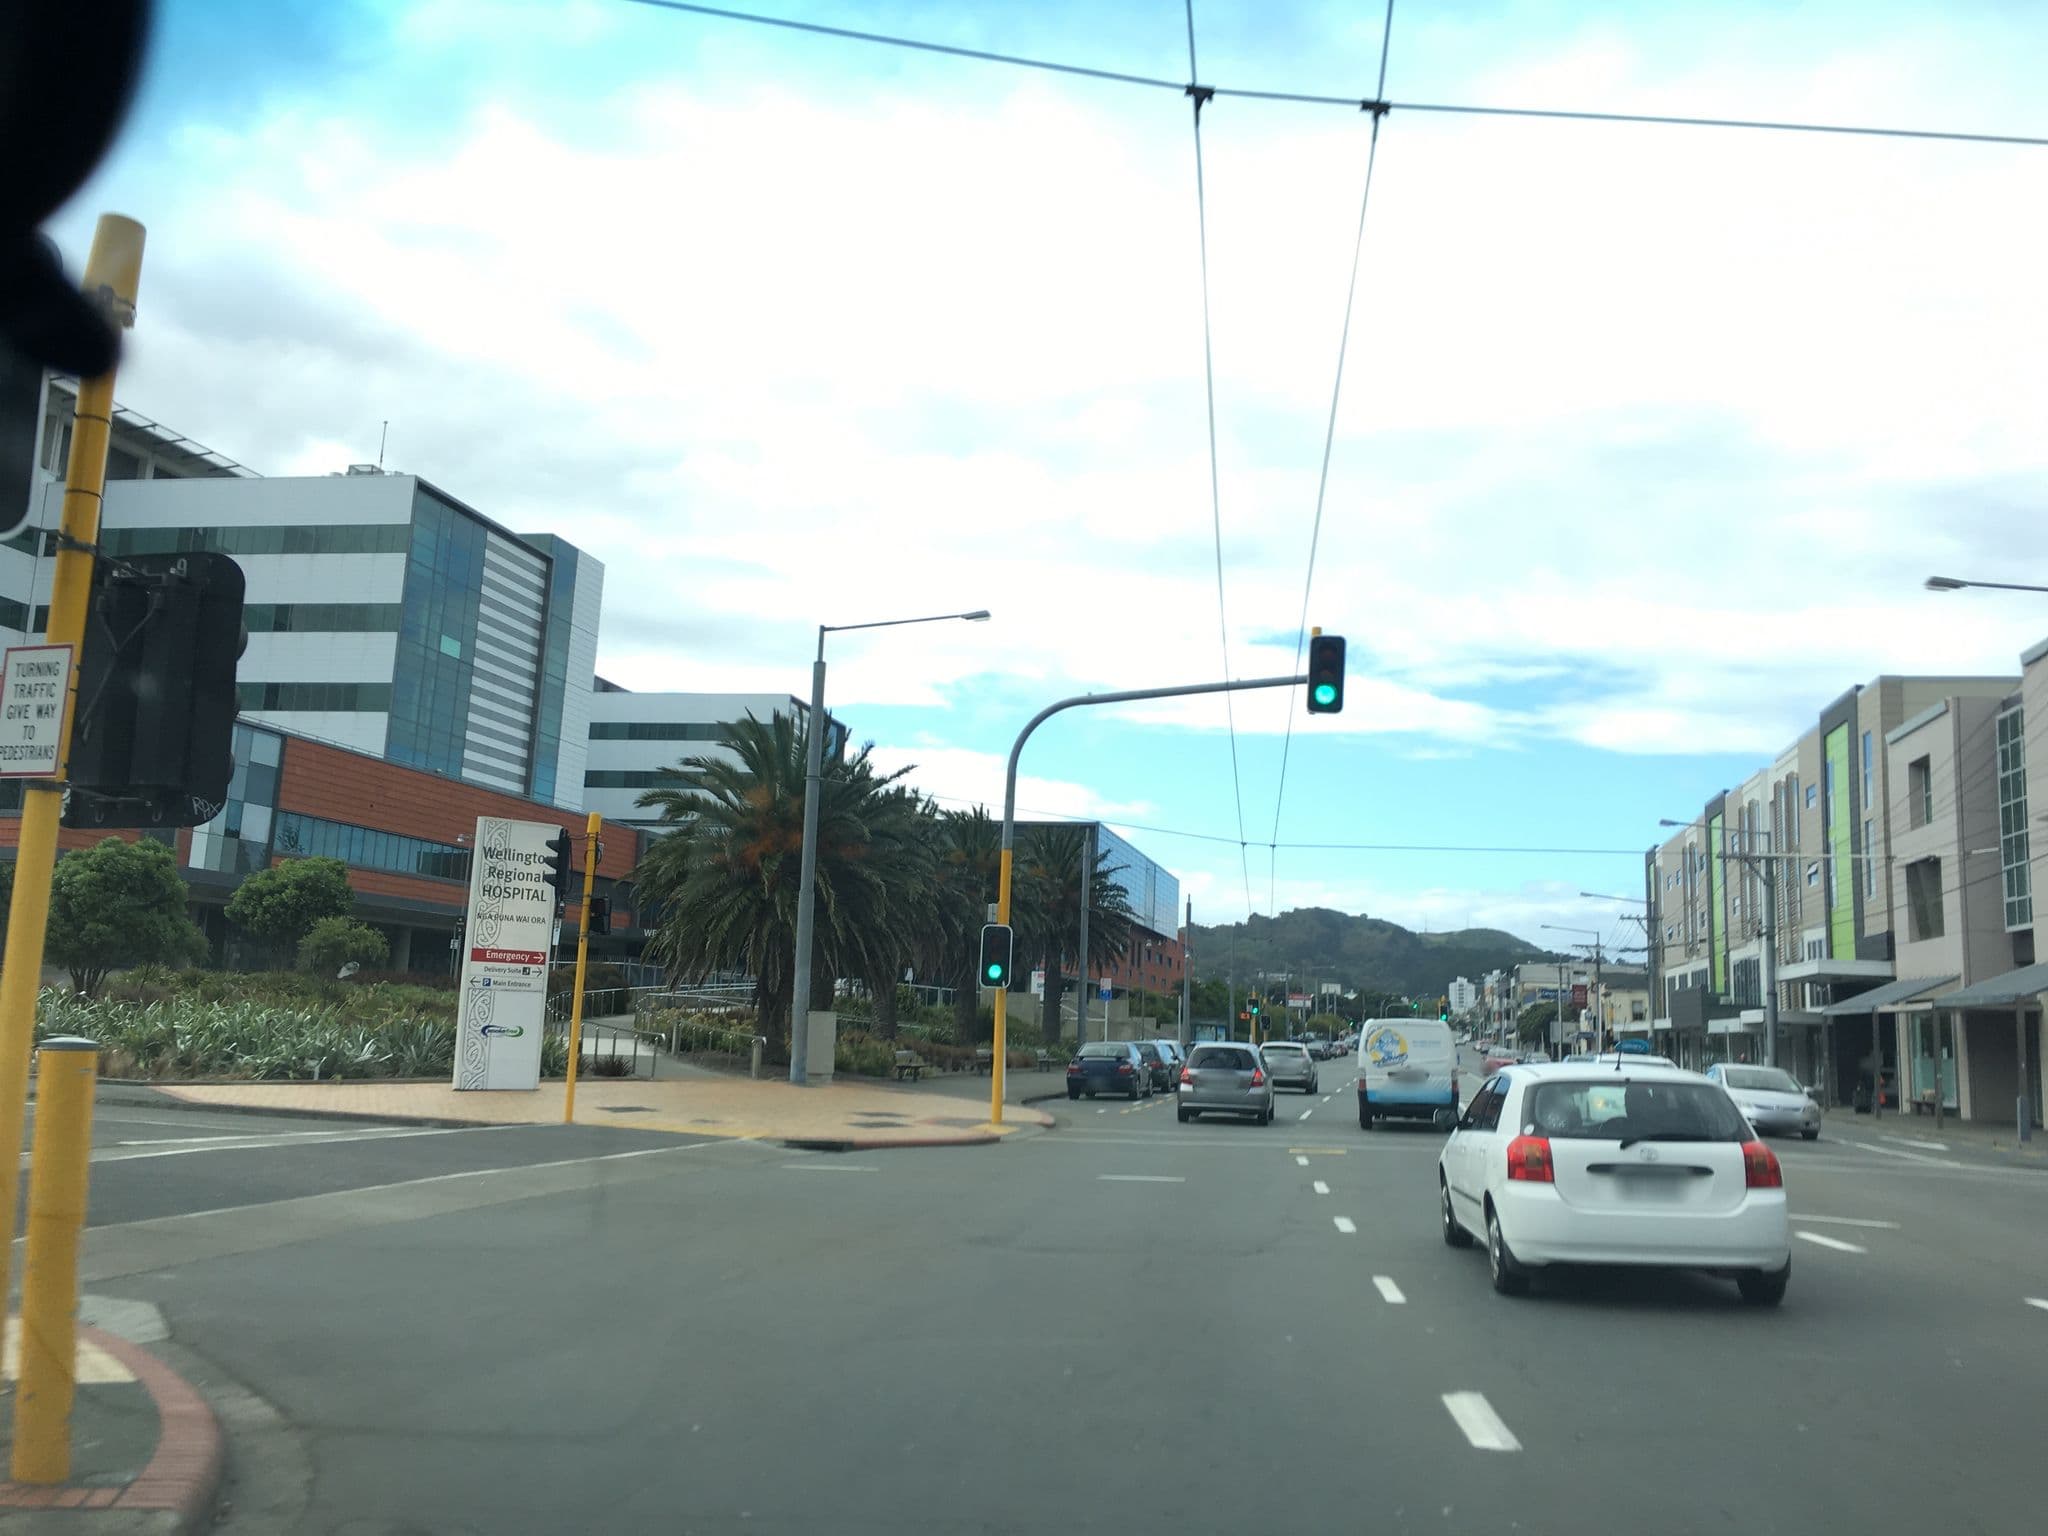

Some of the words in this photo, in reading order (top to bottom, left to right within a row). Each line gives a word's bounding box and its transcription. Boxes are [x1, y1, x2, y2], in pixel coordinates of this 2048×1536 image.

[16, 662, 61, 678] TURNING
[13, 682, 57, 699] TRAFFIC
[6, 704, 31, 720] GIVE
[36, 704, 57, 719] WAY
[23, 725, 35, 740] TO
[483, 846, 546, 866] Wellingto
[488, 866, 546, 884] Regional
[482, 885, 547, 902] HOSPITAL
[494, 914, 514, 922] PUNA
[515, 915, 529, 923] WAI
[530, 916, 546, 924] ORA
[486, 951, 530, 962] Emergency
[484, 966, 507, 974] Delivery
